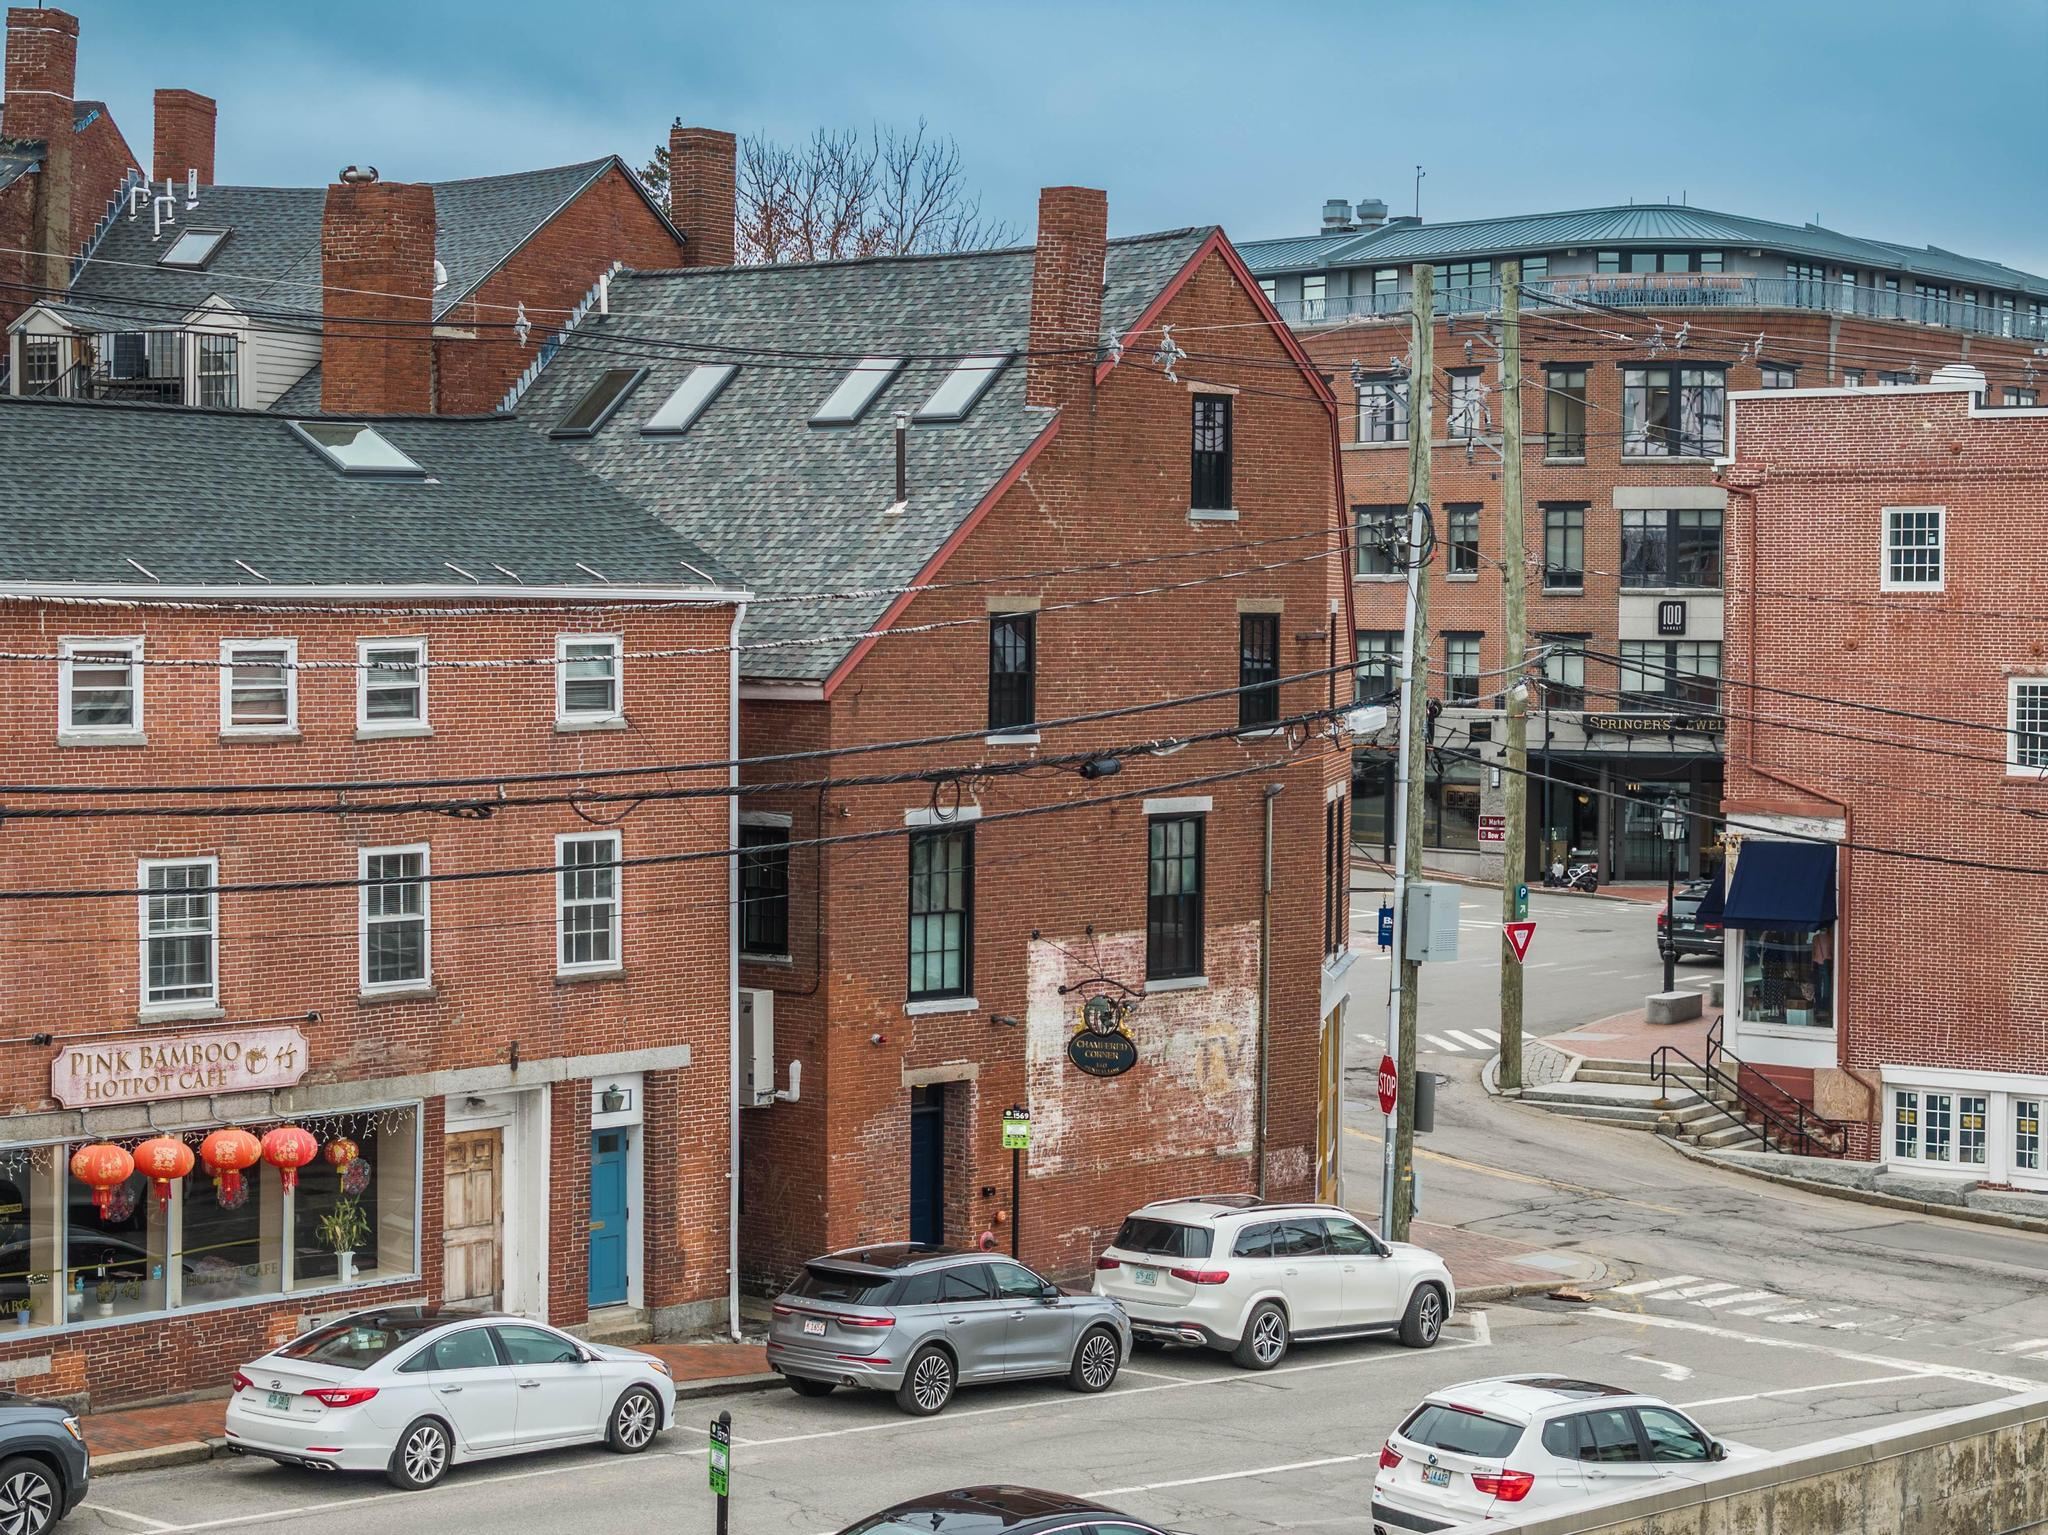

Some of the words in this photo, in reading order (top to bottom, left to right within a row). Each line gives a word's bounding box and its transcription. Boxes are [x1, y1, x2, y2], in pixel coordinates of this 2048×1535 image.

[1663, 605, 1682, 625] 100
[1675, 718, 1724, 731] EWEL
[1487, 831, 1499, 839] Bow
[1520, 887, 1527, 898] P
[70, 1051, 132, 1077] PINK
[139, 1041, 242, 1070] BAMBOO
[1084, 1050, 1119, 1060] CORNER
[85, 1074, 172, 1100] HOTPOT
[178, 1068, 228, 1090] CAFE
[1379, 1071, 1396, 1097] STOP
[1013, 1112, 1029, 1120] 1569
